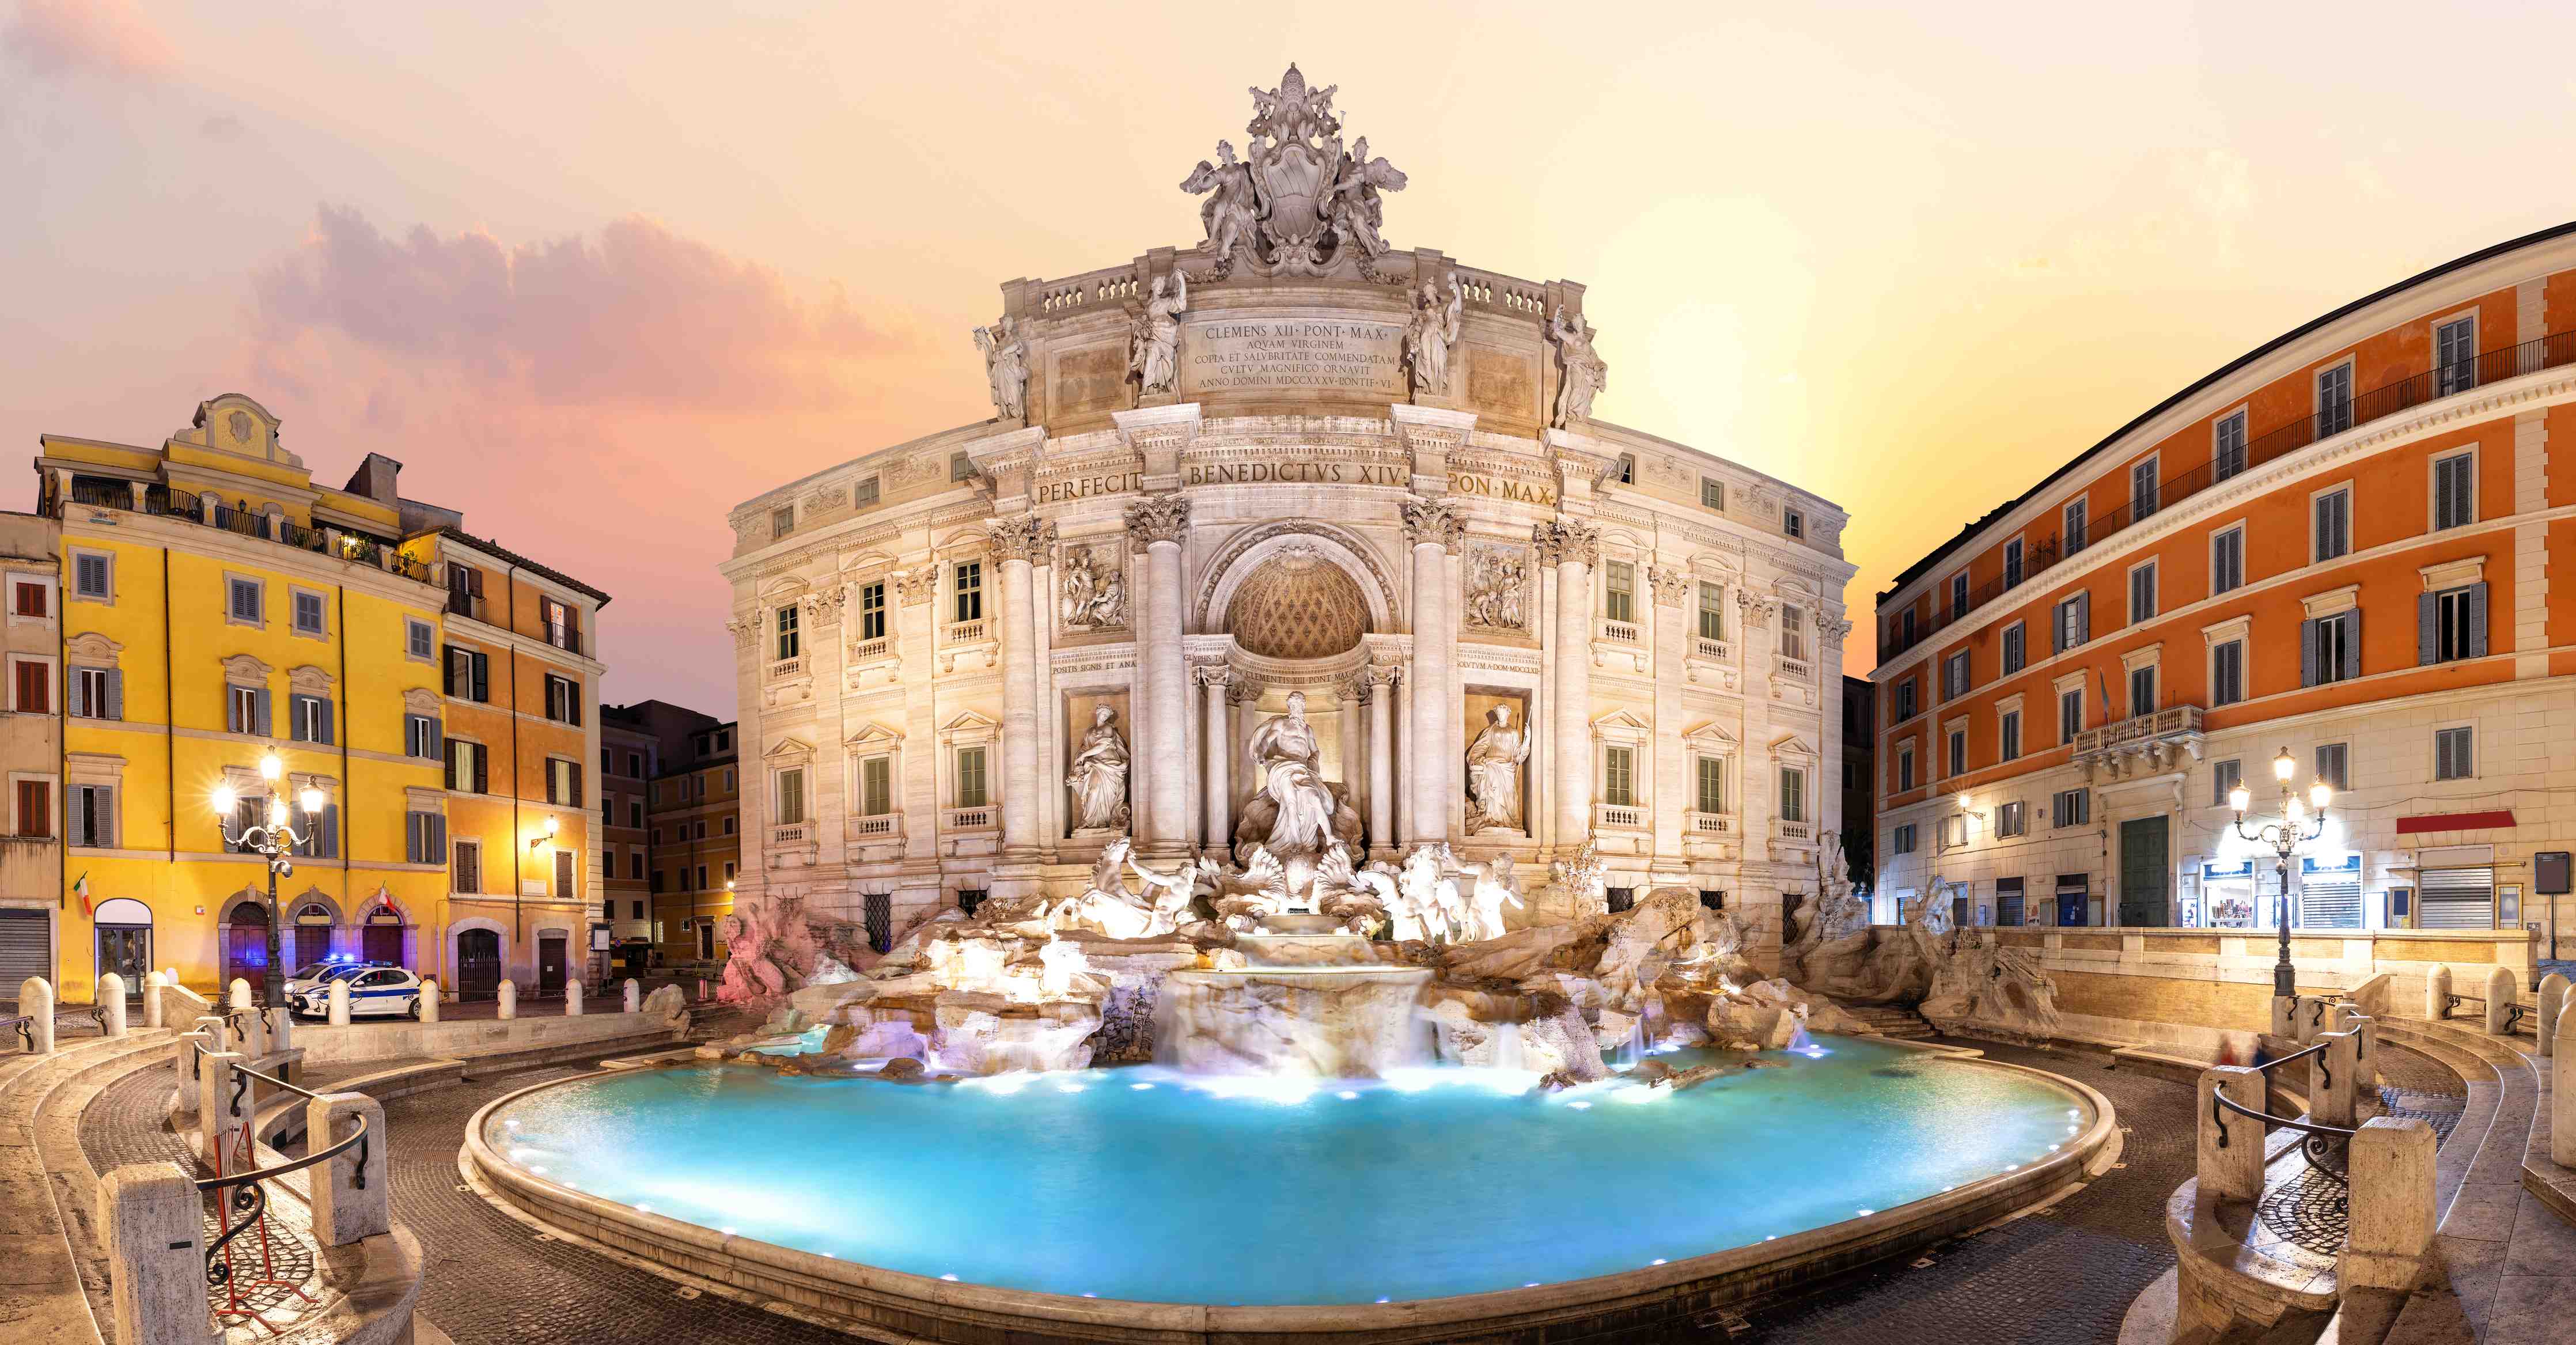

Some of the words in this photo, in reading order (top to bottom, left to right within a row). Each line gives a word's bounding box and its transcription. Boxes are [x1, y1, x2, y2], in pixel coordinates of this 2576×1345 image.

[1206, 325, 1267, 339] CLEMENS
[1248, 340, 1285, 350] AQVAM
[1291, 340, 1343, 349] VIRGINEM
[1195, 354, 1225, 364] COPIA
[1229, 353, 1240, 362] ET
[1244, 352, 1309, 361] SALVBRITATE
[1314, 353, 1395, 365] COMMENDATAM
[1221, 365, 1253, 374] CVLTV
[1260, 364, 1319, 373] MAGNIFICO
[1324, 364, 1370, 374] ORNAVIT
[1199, 378, 1229, 388] ANNO
[1233, 377, 1271, 385] DOMINI
[1039, 471, 1143, 503] PERFECIT
[1190, 463, 1340, 484] BENEDICTVS
[1053, 665, 1078, 675] POSITIS
[1081, 663, 1102, 672] SIGNIS
[1245, 671, 1290, 685] CLEMENTIS
